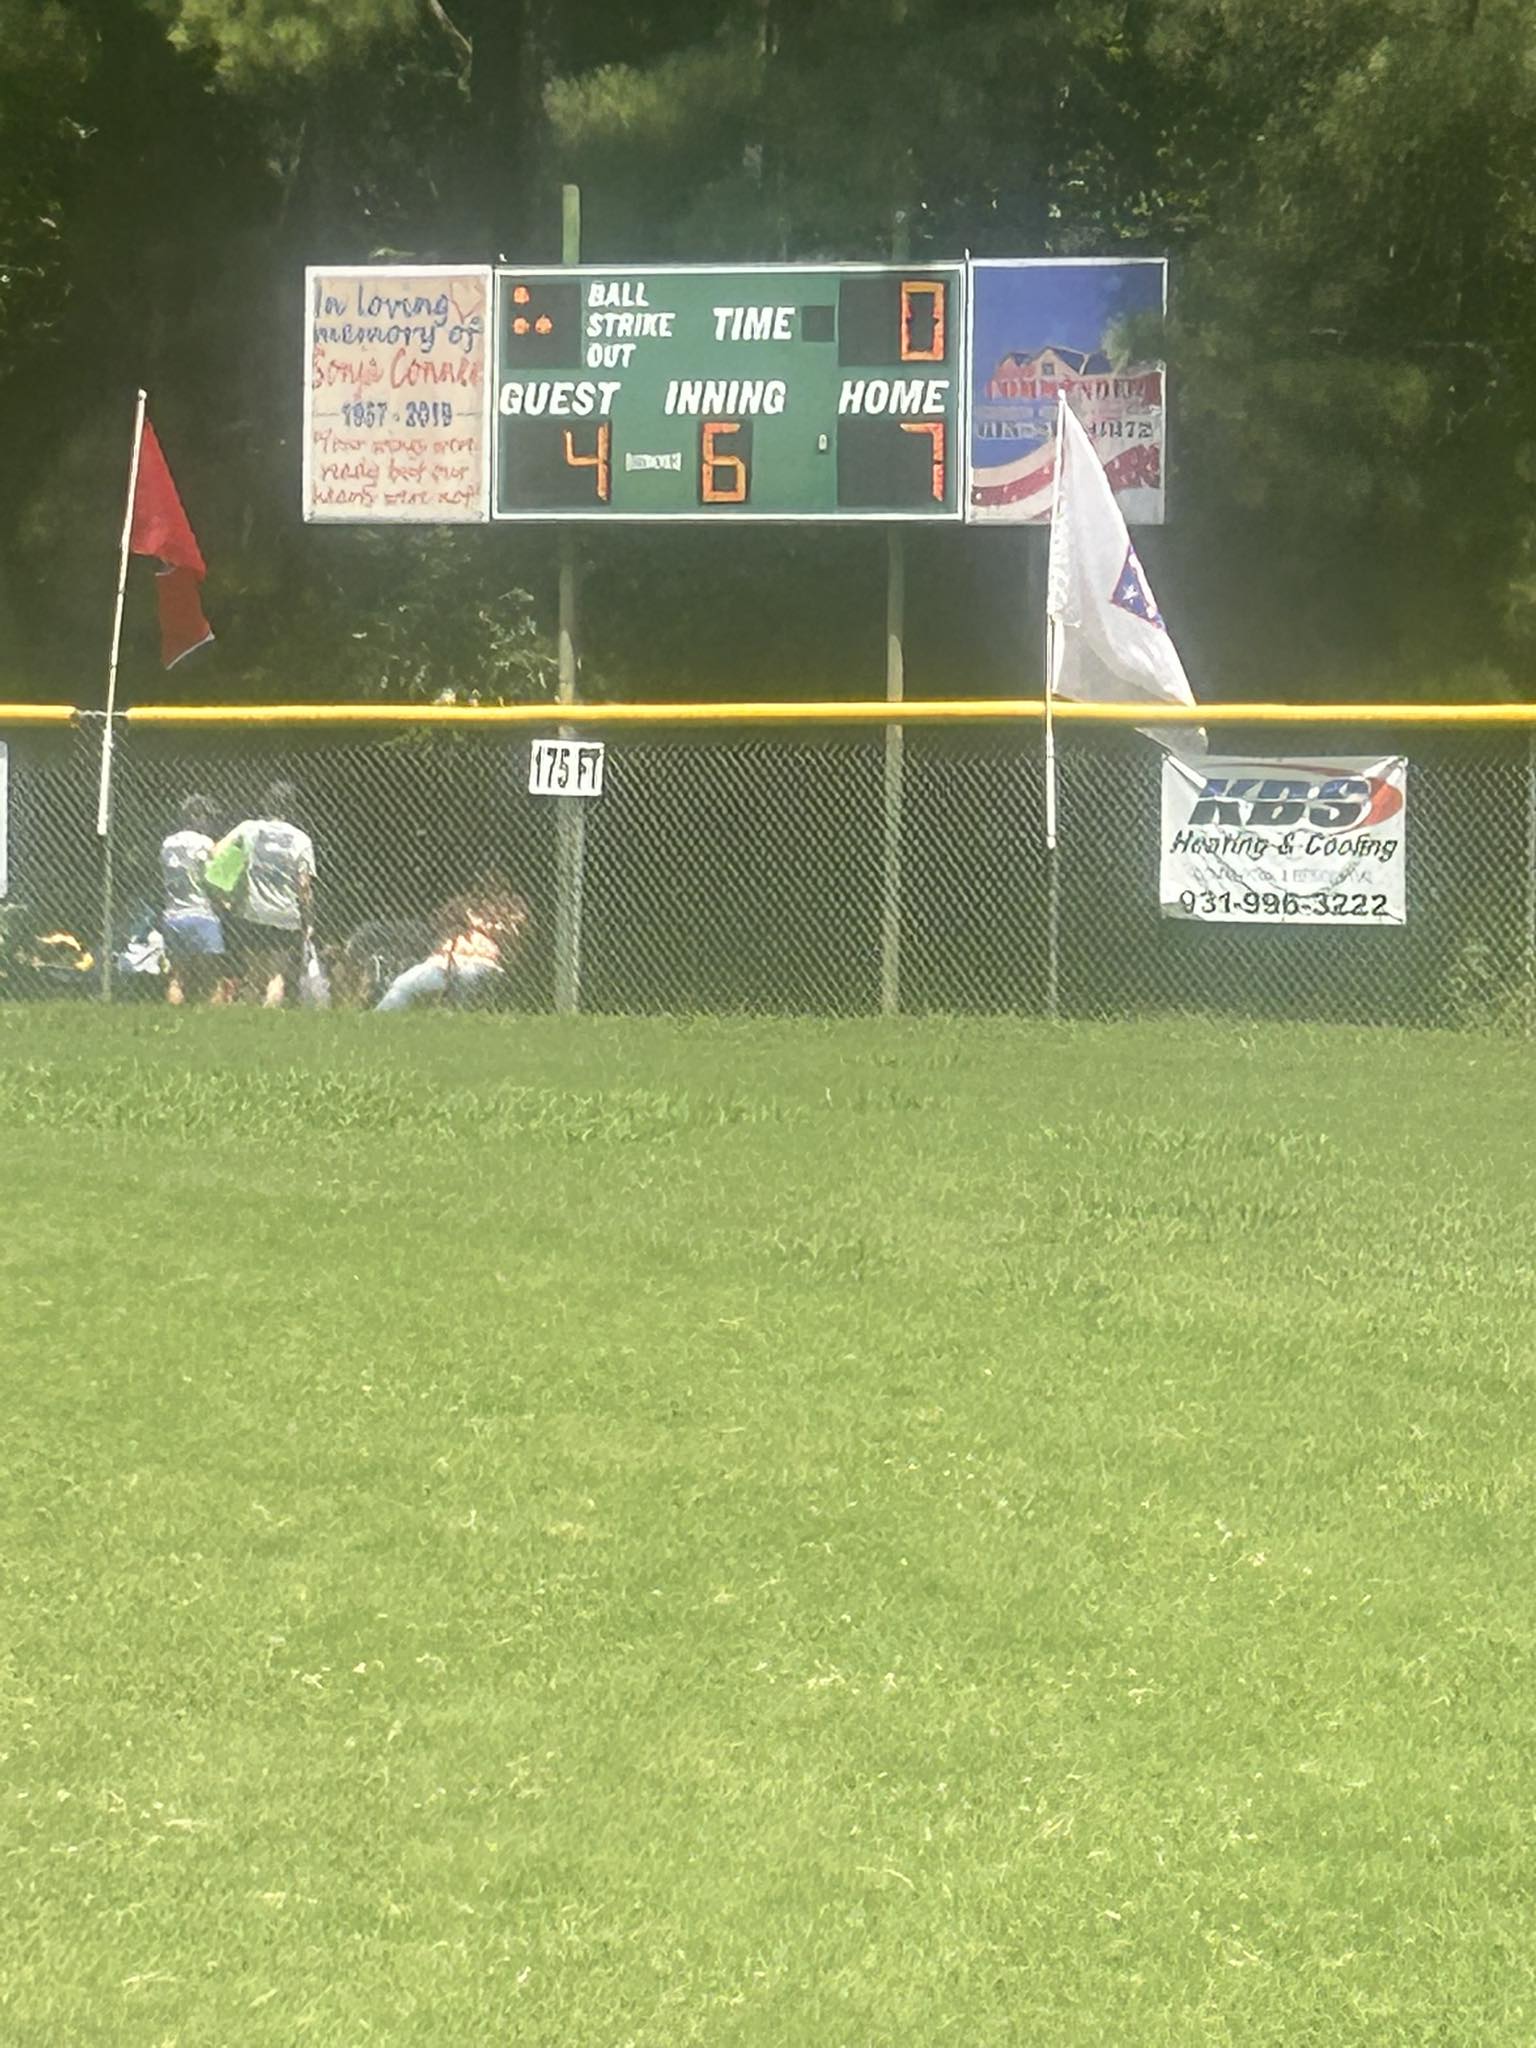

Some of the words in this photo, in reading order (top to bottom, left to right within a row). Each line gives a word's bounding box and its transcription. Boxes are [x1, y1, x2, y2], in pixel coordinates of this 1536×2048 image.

[313, 280, 347, 318] In
[357, 280, 449, 327] loving
[588, 281, 650, 308] BALL
[313, 323, 437, 354] memory
[448, 317, 484, 354] of
[587, 311, 676, 340] STRIKE
[713, 306, 796, 341] TIME
[901, 281, 946, 362] 0
[587, 343, 636, 369] OUT
[499, 382, 622, 416] GUEST
[665, 380, 787, 415] INNING
[839, 379, 950, 415] HOME
[562, 421, 610, 503] 4
[701, 421, 747, 504] 6
[899, 421, 946, 503] 7
[535, 746, 570, 788] 175
[577, 747, 601, 789] FT
[1170, 830, 1269, 861] Heating
[1277, 831, 1296, 856] &
[1305, 832, 1398, 863] Cooling
[1179, 888, 1390, 917] 931-996-3222
